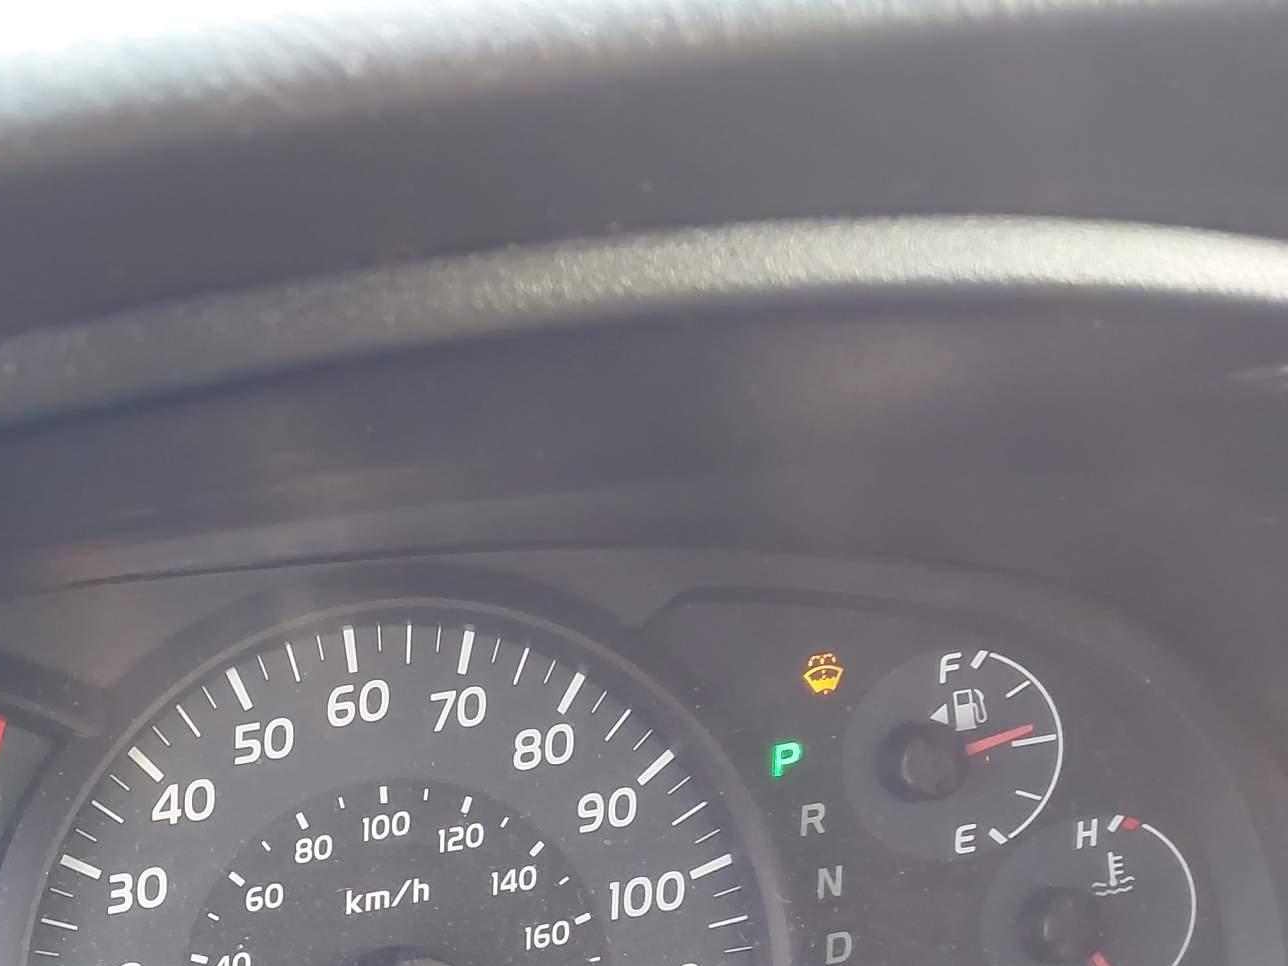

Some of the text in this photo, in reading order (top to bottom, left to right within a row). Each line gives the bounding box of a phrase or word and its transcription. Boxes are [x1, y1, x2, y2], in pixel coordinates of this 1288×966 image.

[939, 652, 962, 684] F
[327, 679, 390, 727] 60
[430, 686, 487, 732] 70
[234, 717, 294, 765] 50
[513, 723, 574, 771] 80
[771, 742, 803, 777] P
[151, 778, 215, 825] 40
[577, 787, 637, 834] 90
[362, 810, 411, 842] 100
[800, 802, 826, 837] R
[1076, 818, 1098, 849] H
[294, 834, 333, 864] 80
[438, 822, 485, 853] 120
[954, 823, 977, 854] E
[107, 866, 168, 915] 30
[245, 883, 284, 912] 60
[345, 878, 430, 915] km/h
[491, 865, 537, 896] 140
[609, 870, 685, 921] 100
[816, 864, 843, 900] N
[525, 920, 570, 951] 160
[826, 931, 853, 965] D
